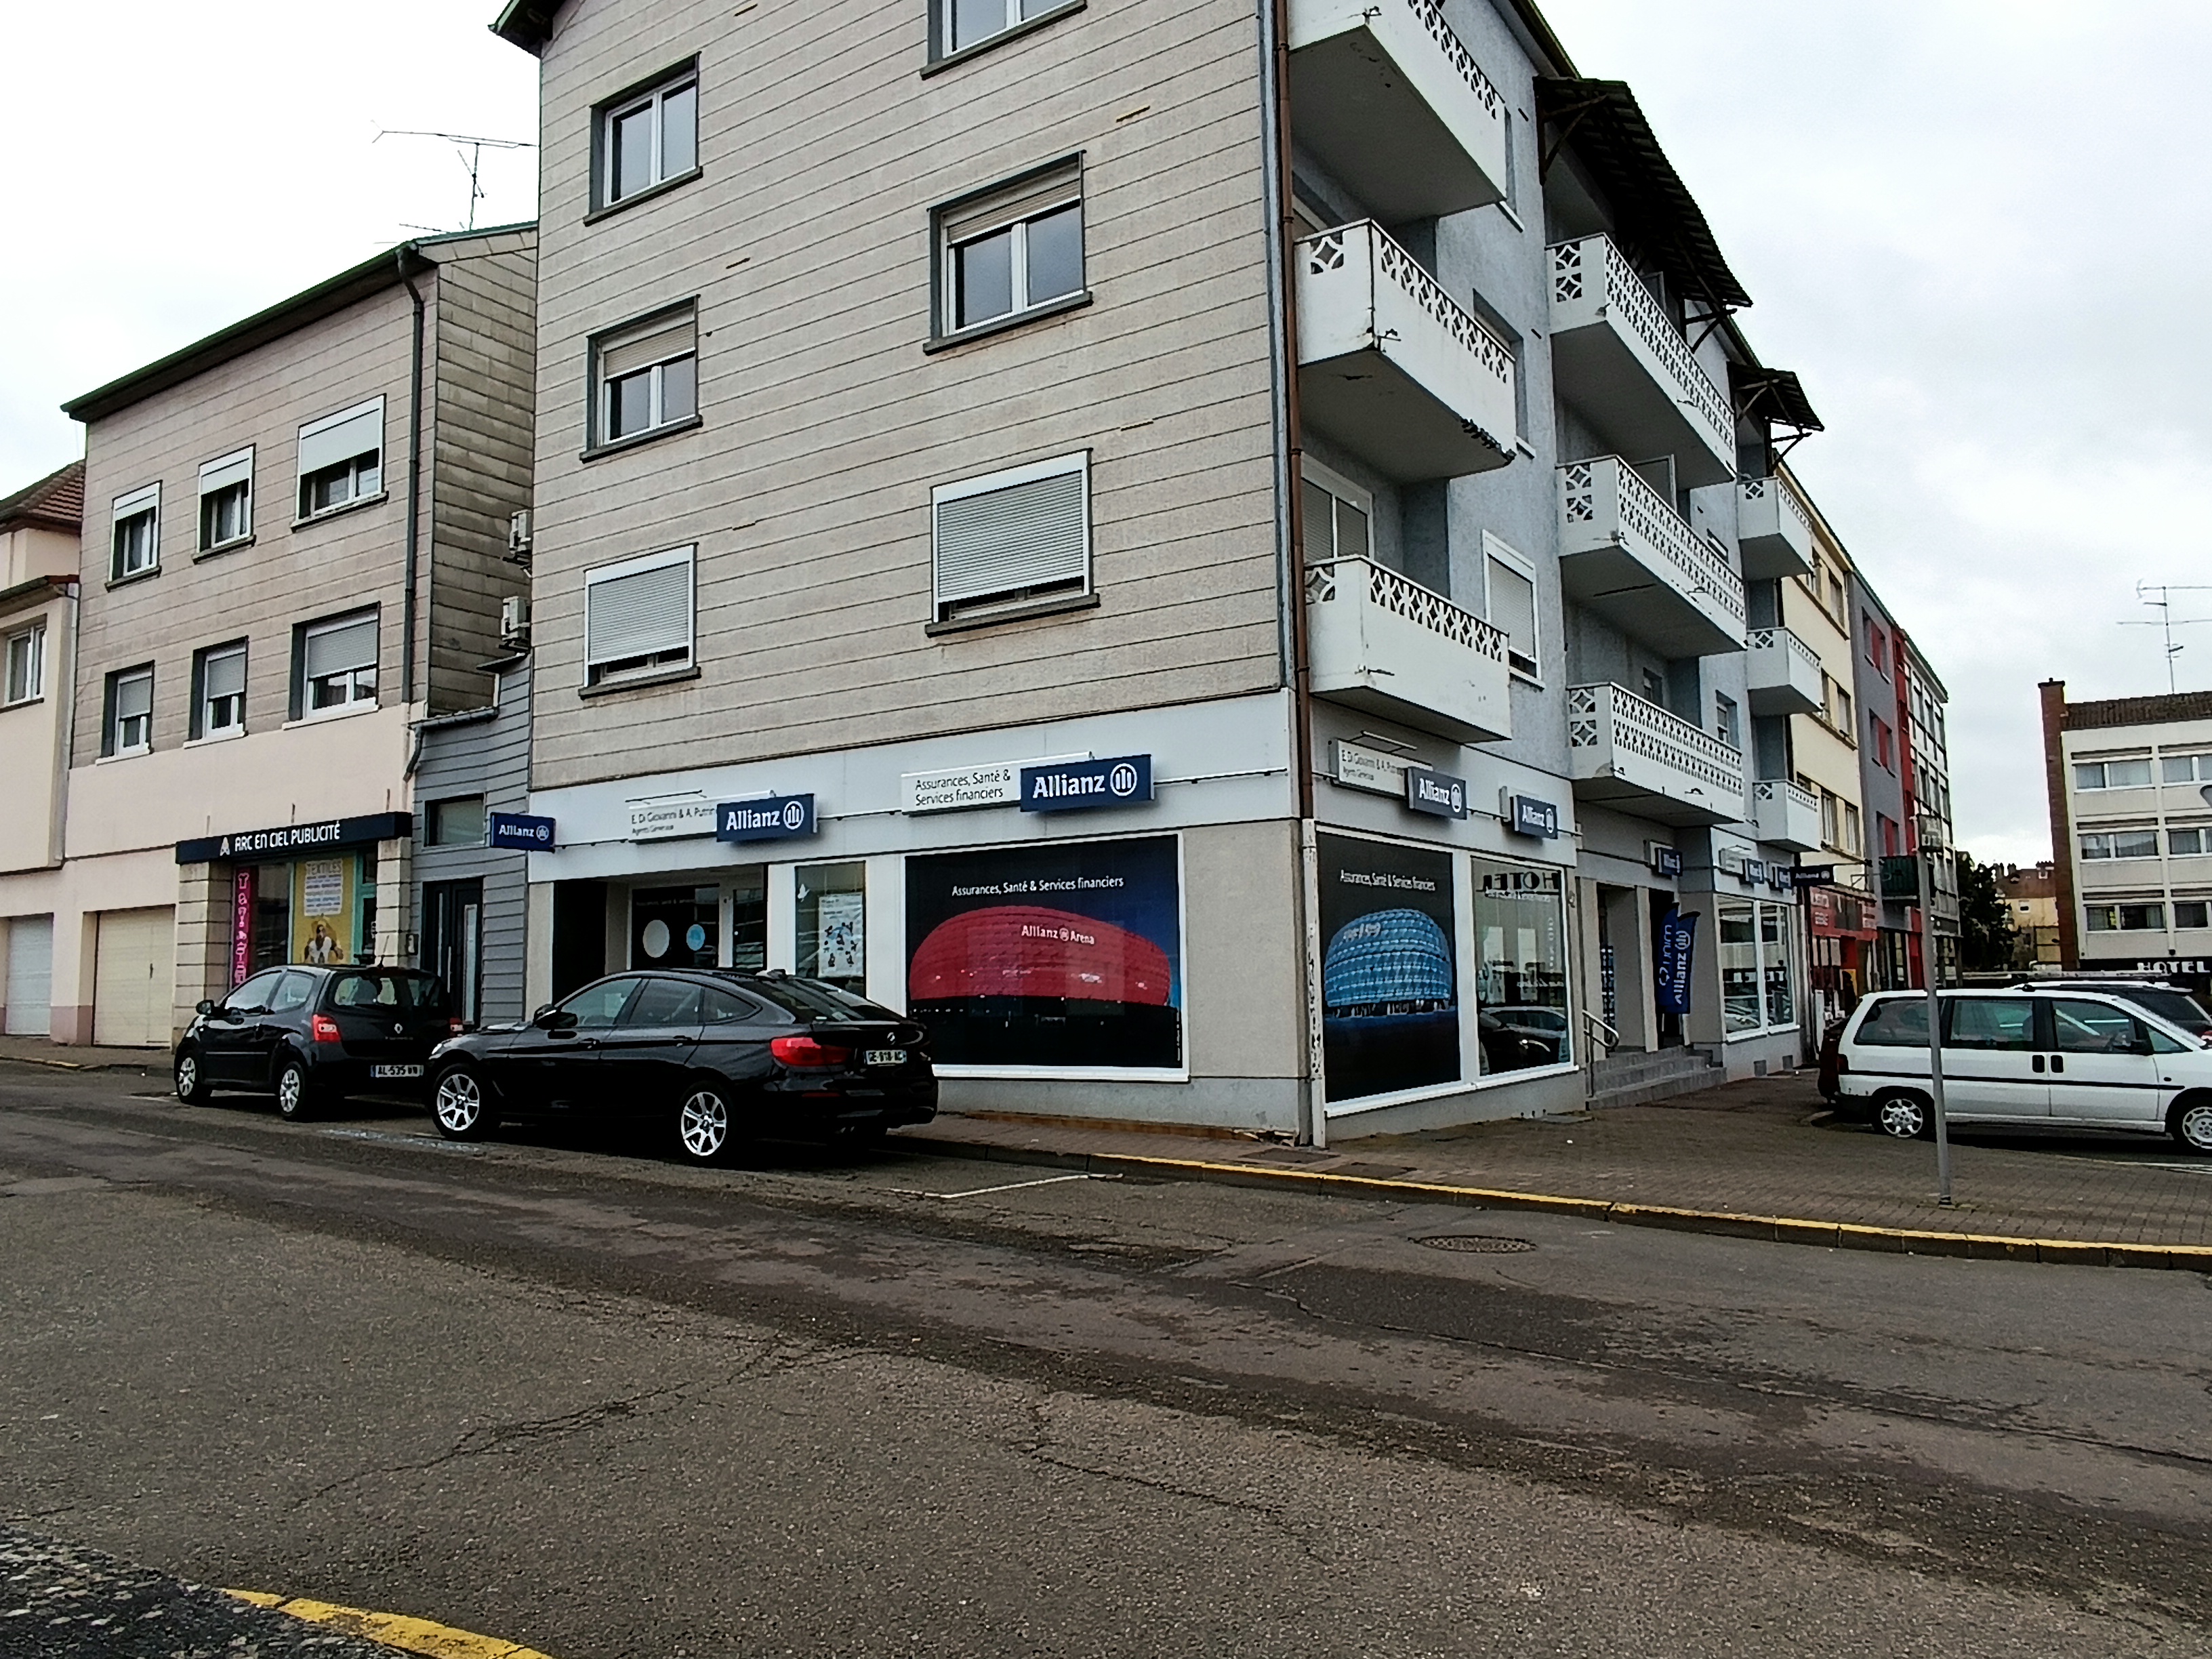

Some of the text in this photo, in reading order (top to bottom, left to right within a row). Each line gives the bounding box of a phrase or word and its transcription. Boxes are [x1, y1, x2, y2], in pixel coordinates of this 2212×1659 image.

[915, 769, 1010, 791] Assurances, Santé &
[1032, 774, 1105, 798] Allianz
[1418, 777, 1450, 805] Allianz
[916, 786, 1003, 806] Services financiers
[499, 824, 535, 838] Allianz
[726, 809, 781, 831] Allianz
[234, 835, 253, 852] ARC
[255, 834, 268, 850] EN
[270, 831, 289, 848] CIEL
[291, 820, 340, 845] PUBLICITÉ
[951, 875, 1124, 897] Assurances, Santé & Services financiers
[1021, 925, 1095, 945] Allianz Arena
[1673, 952, 1687, 1004] Allianz
[2137, 961, 2211, 975] HOTEL
